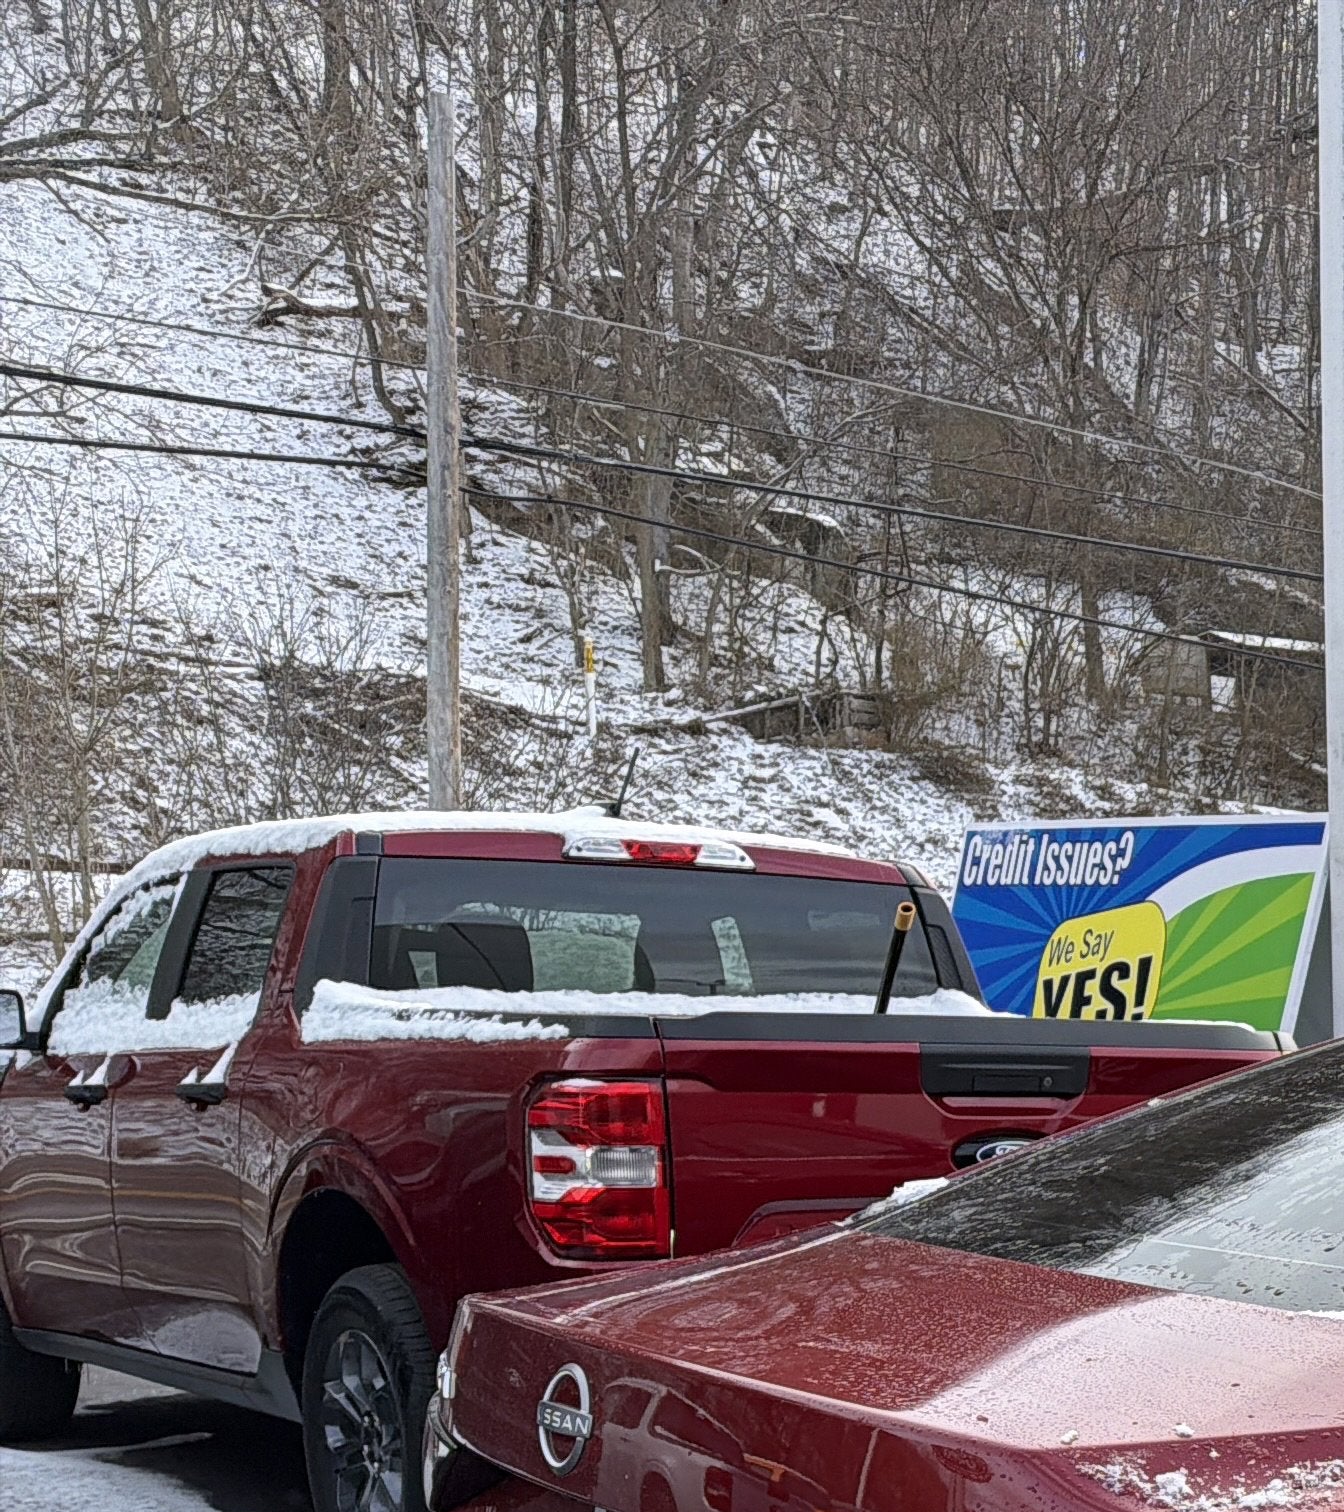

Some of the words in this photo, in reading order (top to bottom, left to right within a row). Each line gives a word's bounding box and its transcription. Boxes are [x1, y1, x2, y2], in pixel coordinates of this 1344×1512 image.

[963, 834, 1034, 886] Credit
[1035, 831, 1134, 886] Issues?
[1048, 935, 1075, 967] We
[1080, 929, 1115, 962] Say
[1043, 955, 1153, 1021] YES!
